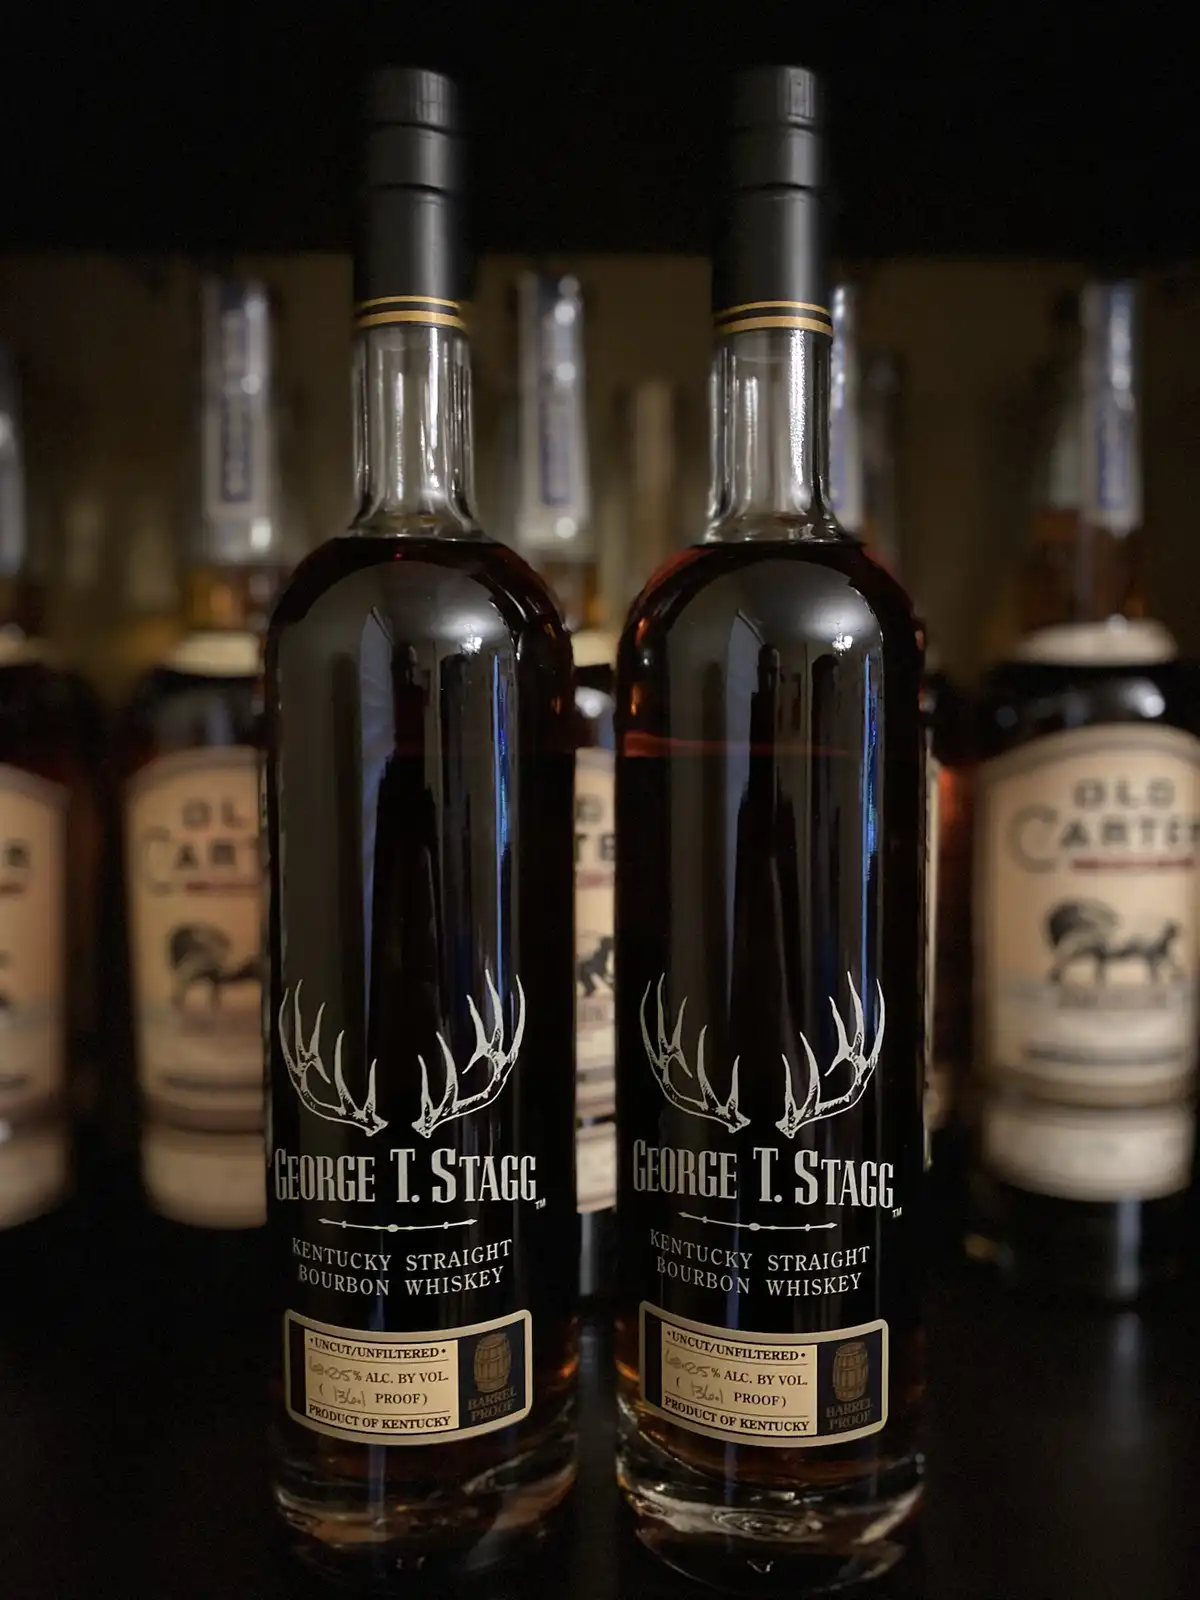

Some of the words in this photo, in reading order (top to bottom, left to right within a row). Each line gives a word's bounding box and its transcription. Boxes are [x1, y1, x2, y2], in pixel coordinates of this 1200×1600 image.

[274, 1148, 376, 1202] GEORGE
[390, 1148, 420, 1203] T.
[431, 1148, 537, 1204] STAGG
[632, 1138, 738, 1199] GEORGE
[753, 1147, 783, 1203] T.
[794, 1149, 894, 1209] STAGG
[291, 1236, 392, 1272] KENTUCKY
[405, 1238, 513, 1272] STRAIGHT
[650, 1228, 753, 1270] KENTUCKY
[767, 1245, 871, 1272] STRAIGHT
[298, 1263, 390, 1297] BOURBON
[404, 1265, 504, 1296] WHISKEY
[656, 1255, 750, 1294] BOURBON
[766, 1272, 862, 1297] WHISKEY
[365, 1372, 394, 1384] ALC.
[398, 1373, 416, 1384] BY
[419, 1371, 449, 1383] VOL.
[724, 1371, 752, 1384] ALC.
[757, 1374, 775, 1386] BY
[778, 1374, 808, 1386] VOL.
[375, 1393, 428, 1406] PROOF)
[467, 1386, 516, 1411] BARREL
[470, 1398, 514, 1422] PROOF
[734, 1391, 787, 1408] PROOF)
[825, 1399, 874, 1418] BARREL
[309, 1404, 359, 1427] PRODUCT
[362, 1417, 378, 1429] OF
[382, 1416, 452, 1430] KENTUCKY
[664, 1395, 716, 1423] PRODUCT
[720, 1414, 737, 1426] OF
[740, 1418, 810, 1432] KENTUCKY
[827, 1410, 872, 1430] PROOF
